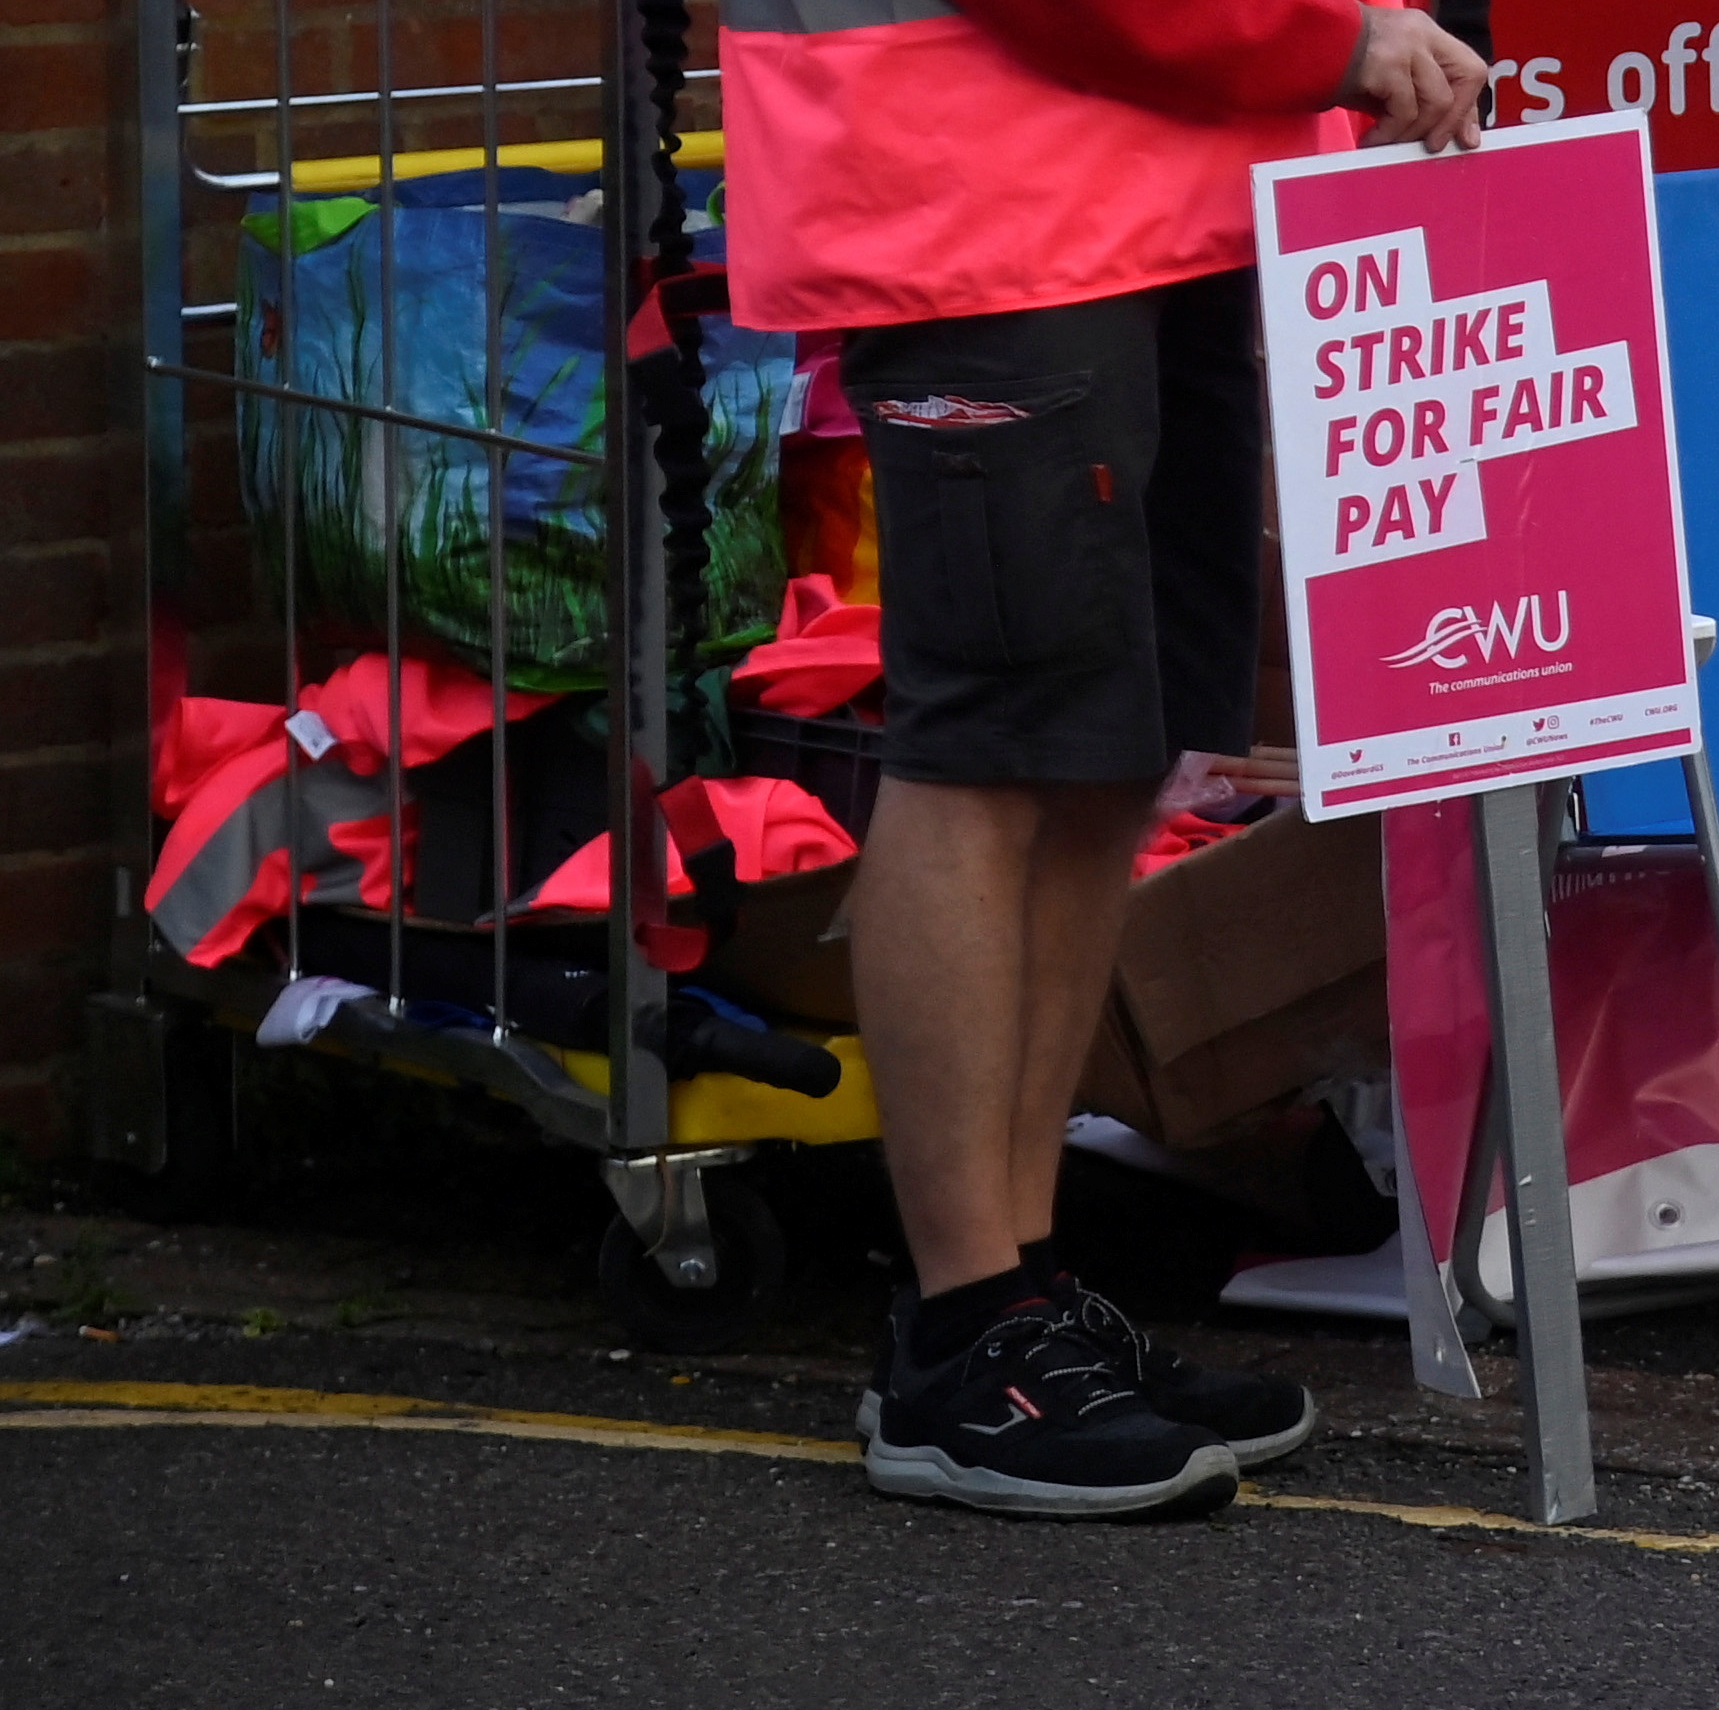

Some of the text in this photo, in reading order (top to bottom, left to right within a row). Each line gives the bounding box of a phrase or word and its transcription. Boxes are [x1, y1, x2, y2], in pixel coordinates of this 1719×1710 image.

[1304, 248, 1401, 321] ON
[1315, 300, 1526, 400] STRIKE
[1325, 364, 1607, 477] FOR FAIR
[1335, 472, 1458, 555] PAY
[1424, 590, 1569, 669] CWU
[1428, 660, 1572, 695] The communications union
[1589, 714, 1624, 726] #TheCWU
